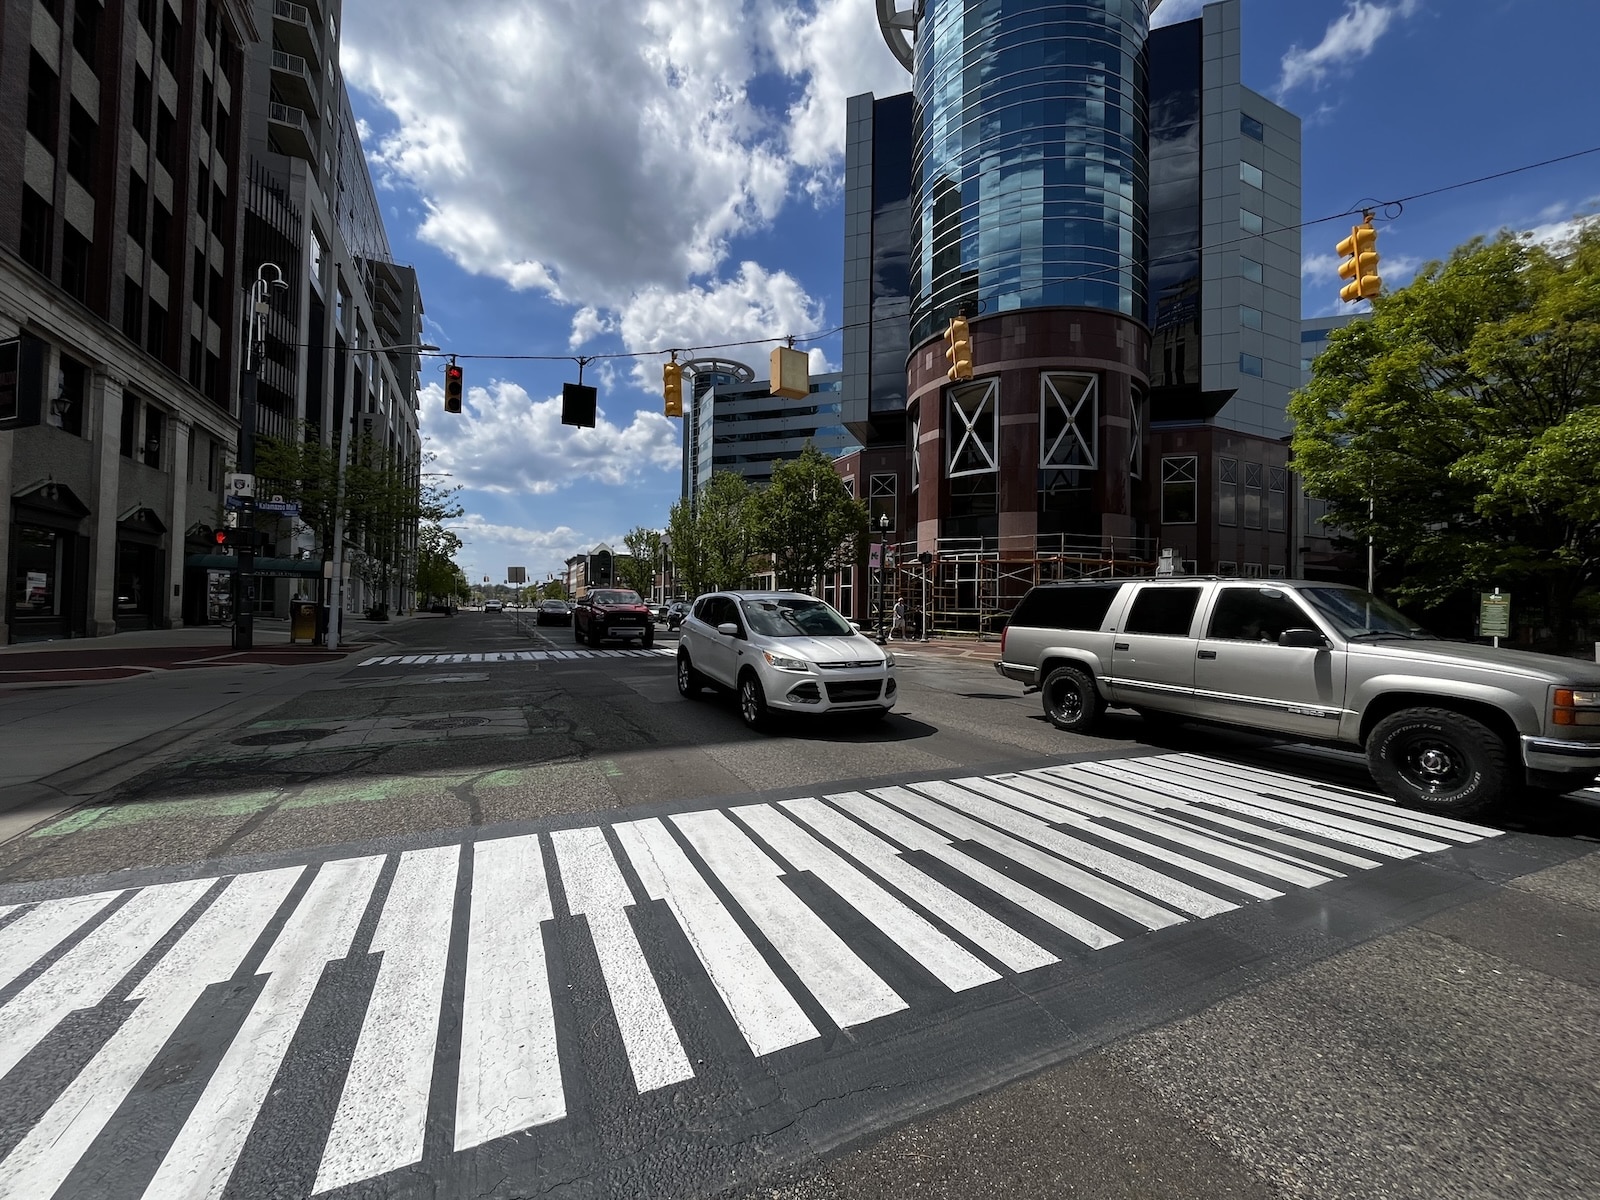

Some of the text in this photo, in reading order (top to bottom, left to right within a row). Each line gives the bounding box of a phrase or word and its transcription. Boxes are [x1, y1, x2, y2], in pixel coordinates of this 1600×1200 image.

[259, 502, 286, 511] Kalamazoo
[286, 503, 297, 511] Mall
[1420, 771, 1481, 802] BFGoodrich
